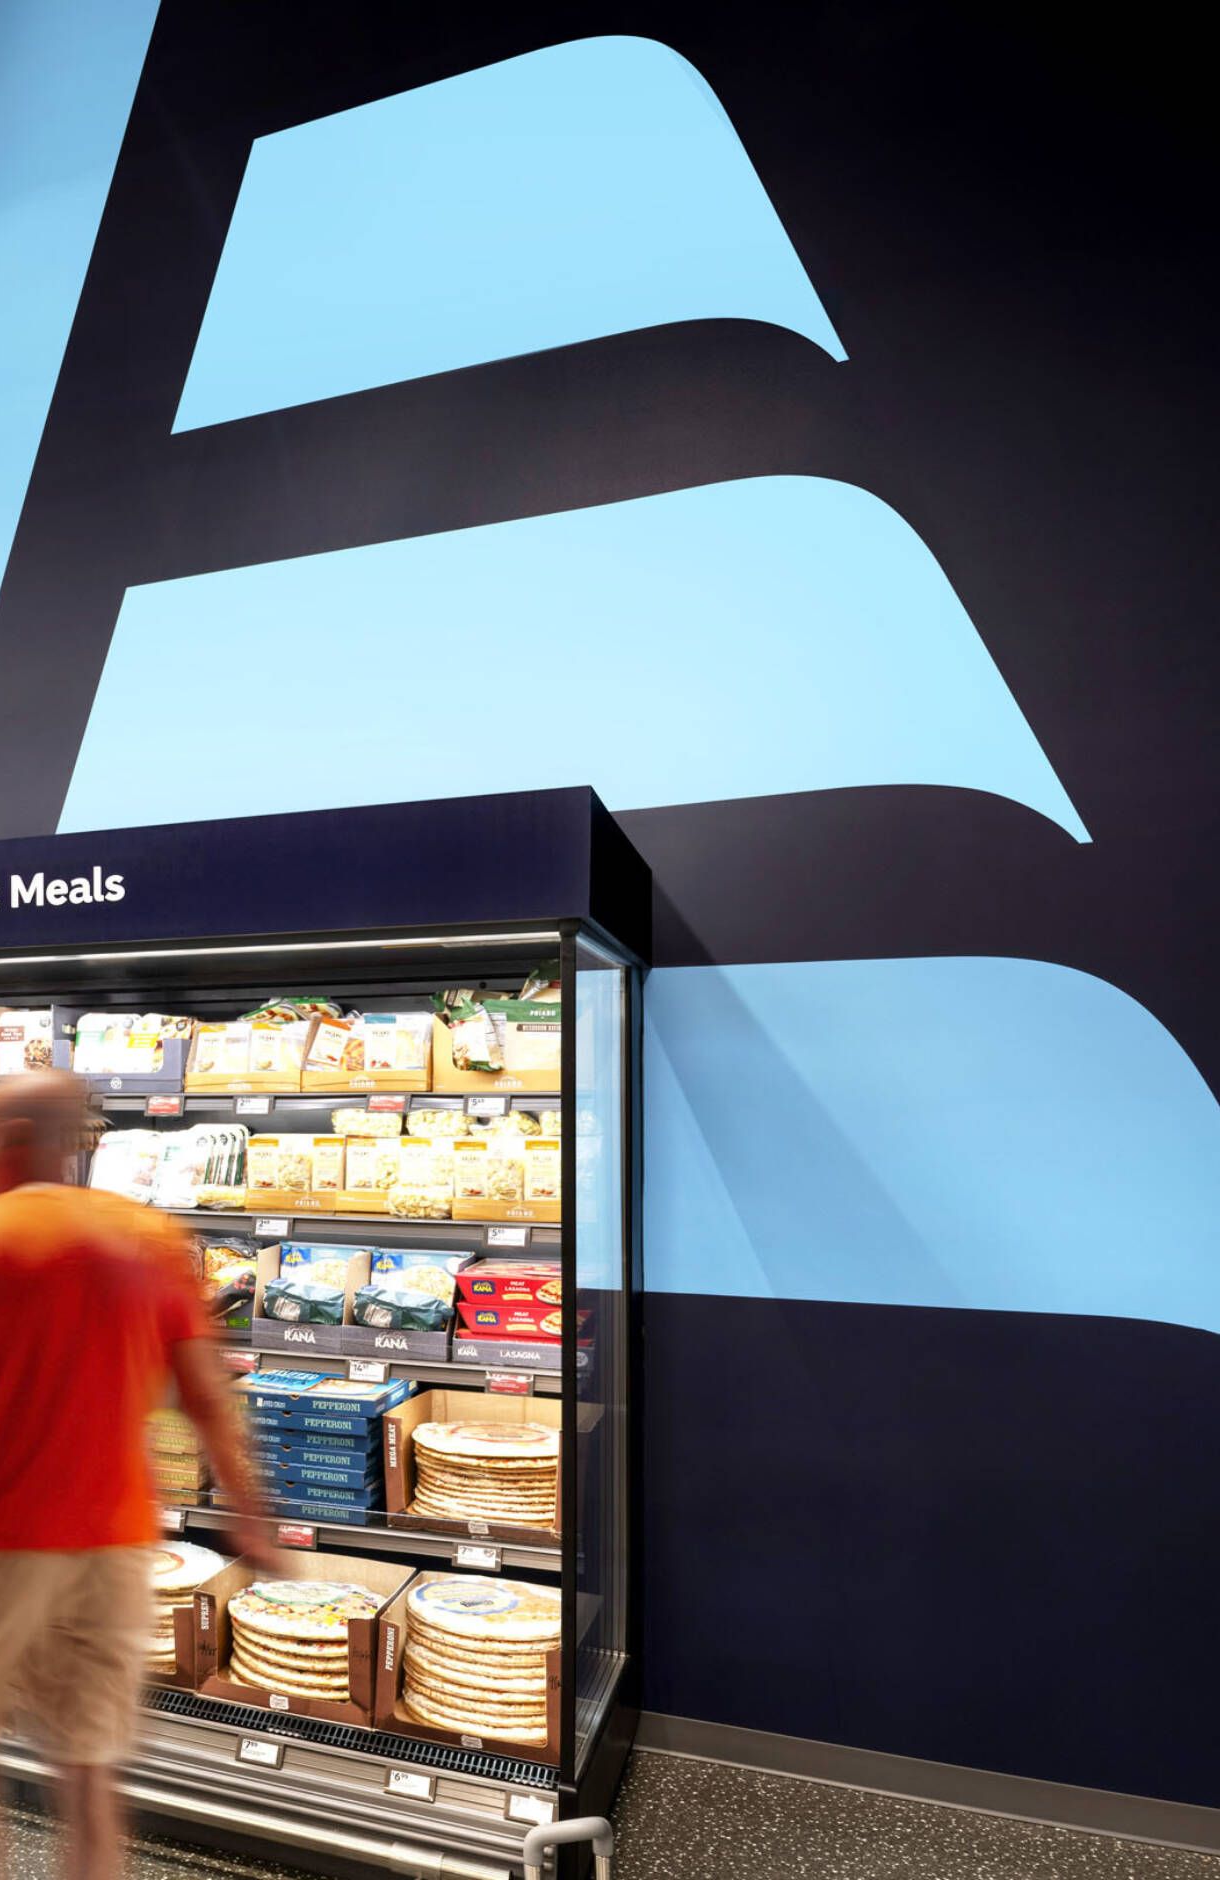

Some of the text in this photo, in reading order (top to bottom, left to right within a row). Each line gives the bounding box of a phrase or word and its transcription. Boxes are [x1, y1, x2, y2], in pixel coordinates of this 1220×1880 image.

[10, 865, 126, 909] Meals
[500, 1349, 541, 1360] LASAGNA
[312, 1400, 361, 1412] PEPPERONI
[304, 1418, 352, 1430] PEPPERONI
[306, 1435, 355, 1447] PEPPERONI
[387, 1423, 397, 1468] MEGA MEAT
[303, 1453, 351, 1465] PEPPERONI
[301, 1469, 348, 1482] PEPPERONI
[307, 1487, 355, 1500] PEPPERONI
[301, 1506, 350, 1519] PEPPERONI
[385, 1627, 395, 1672] PEPPERONI
